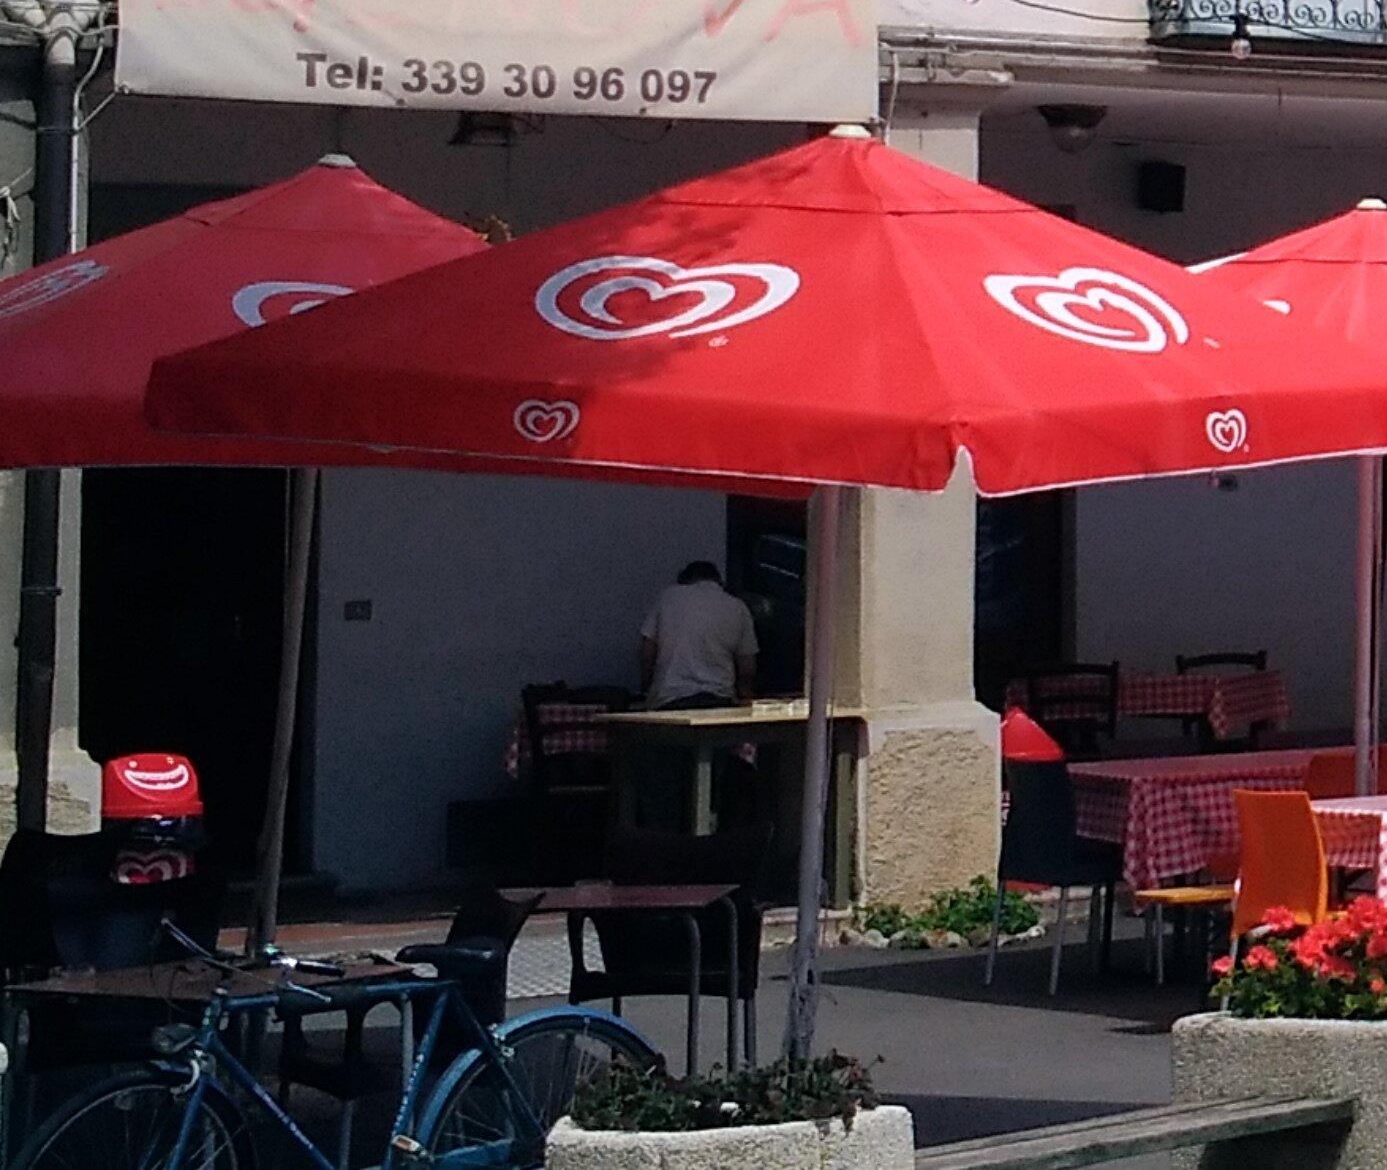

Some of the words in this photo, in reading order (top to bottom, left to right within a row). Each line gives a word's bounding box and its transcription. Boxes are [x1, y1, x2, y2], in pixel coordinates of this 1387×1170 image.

[297, 52, 385, 91] Tel:
[401, 59, 486, 96] 339
[503, 64, 557, 100] 30
[573, 67, 625, 102] 96
[640, 68, 718, 104] 097
